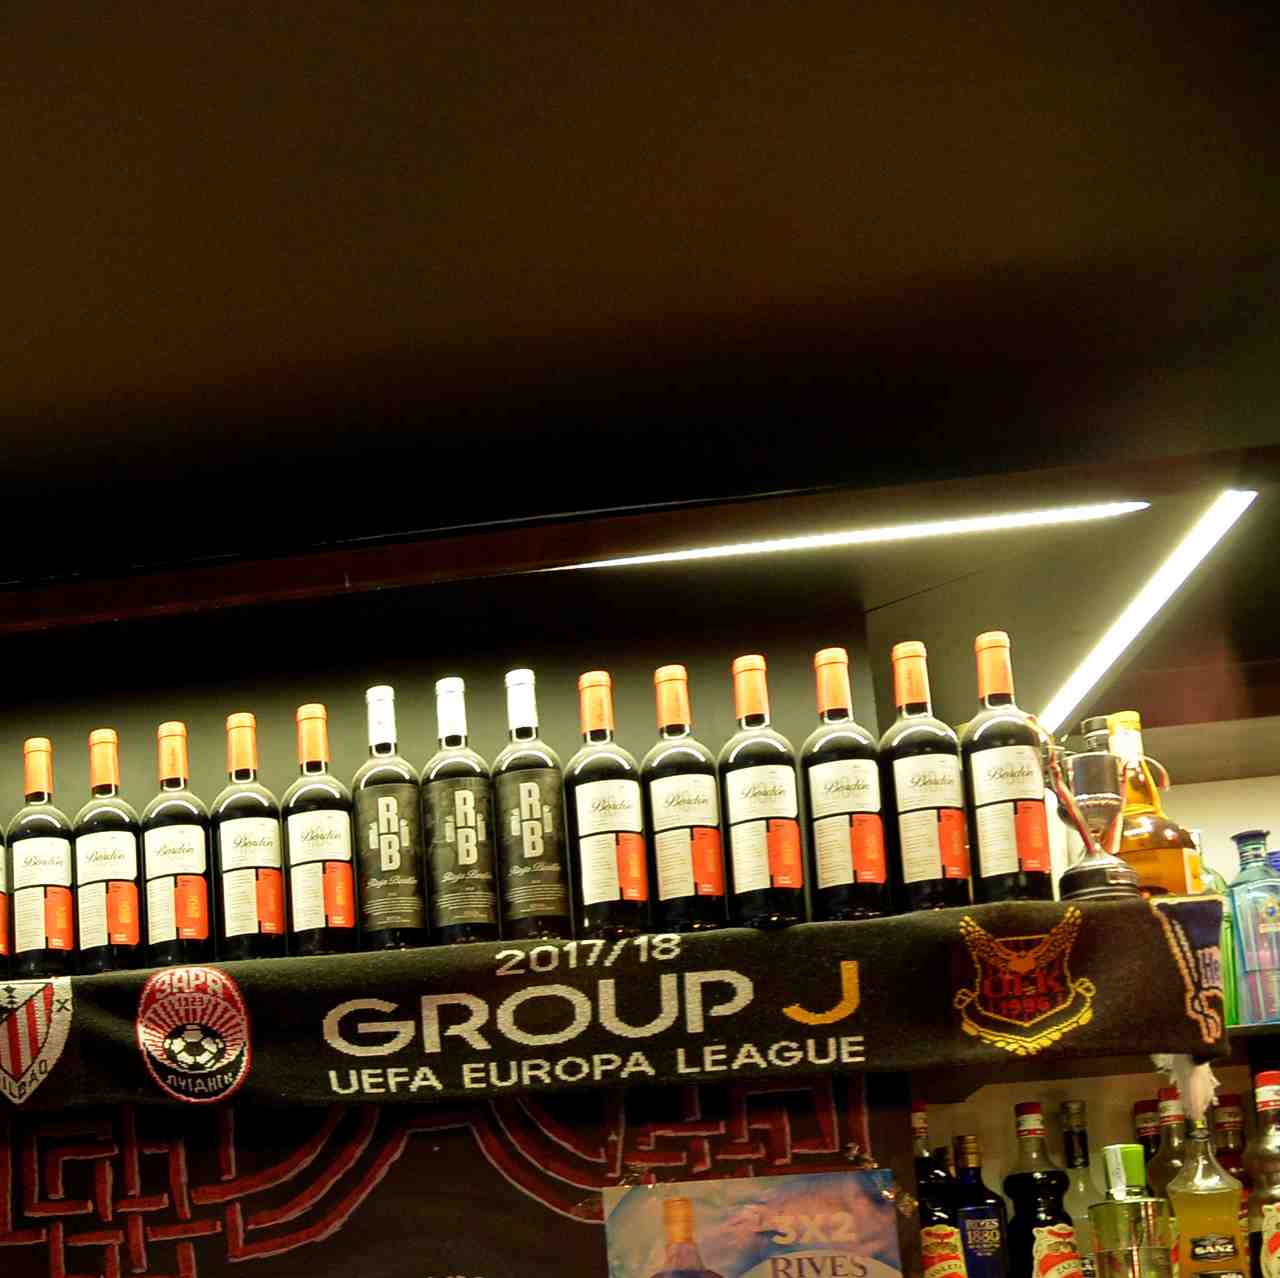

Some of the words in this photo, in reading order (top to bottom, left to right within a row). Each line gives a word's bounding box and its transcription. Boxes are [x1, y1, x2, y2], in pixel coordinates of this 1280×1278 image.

[495, 933, 683, 976] 2017/18
[322, 967, 754, 1057] GROUP
[782, 960, 862, 1026] J
[327, 1066, 443, 1095] UEFA
[461, 1051, 656, 1090] EUROPA
[676, 1035, 866, 1074] LEAGUE
[1195, 1243, 1234, 1254] SANZ
